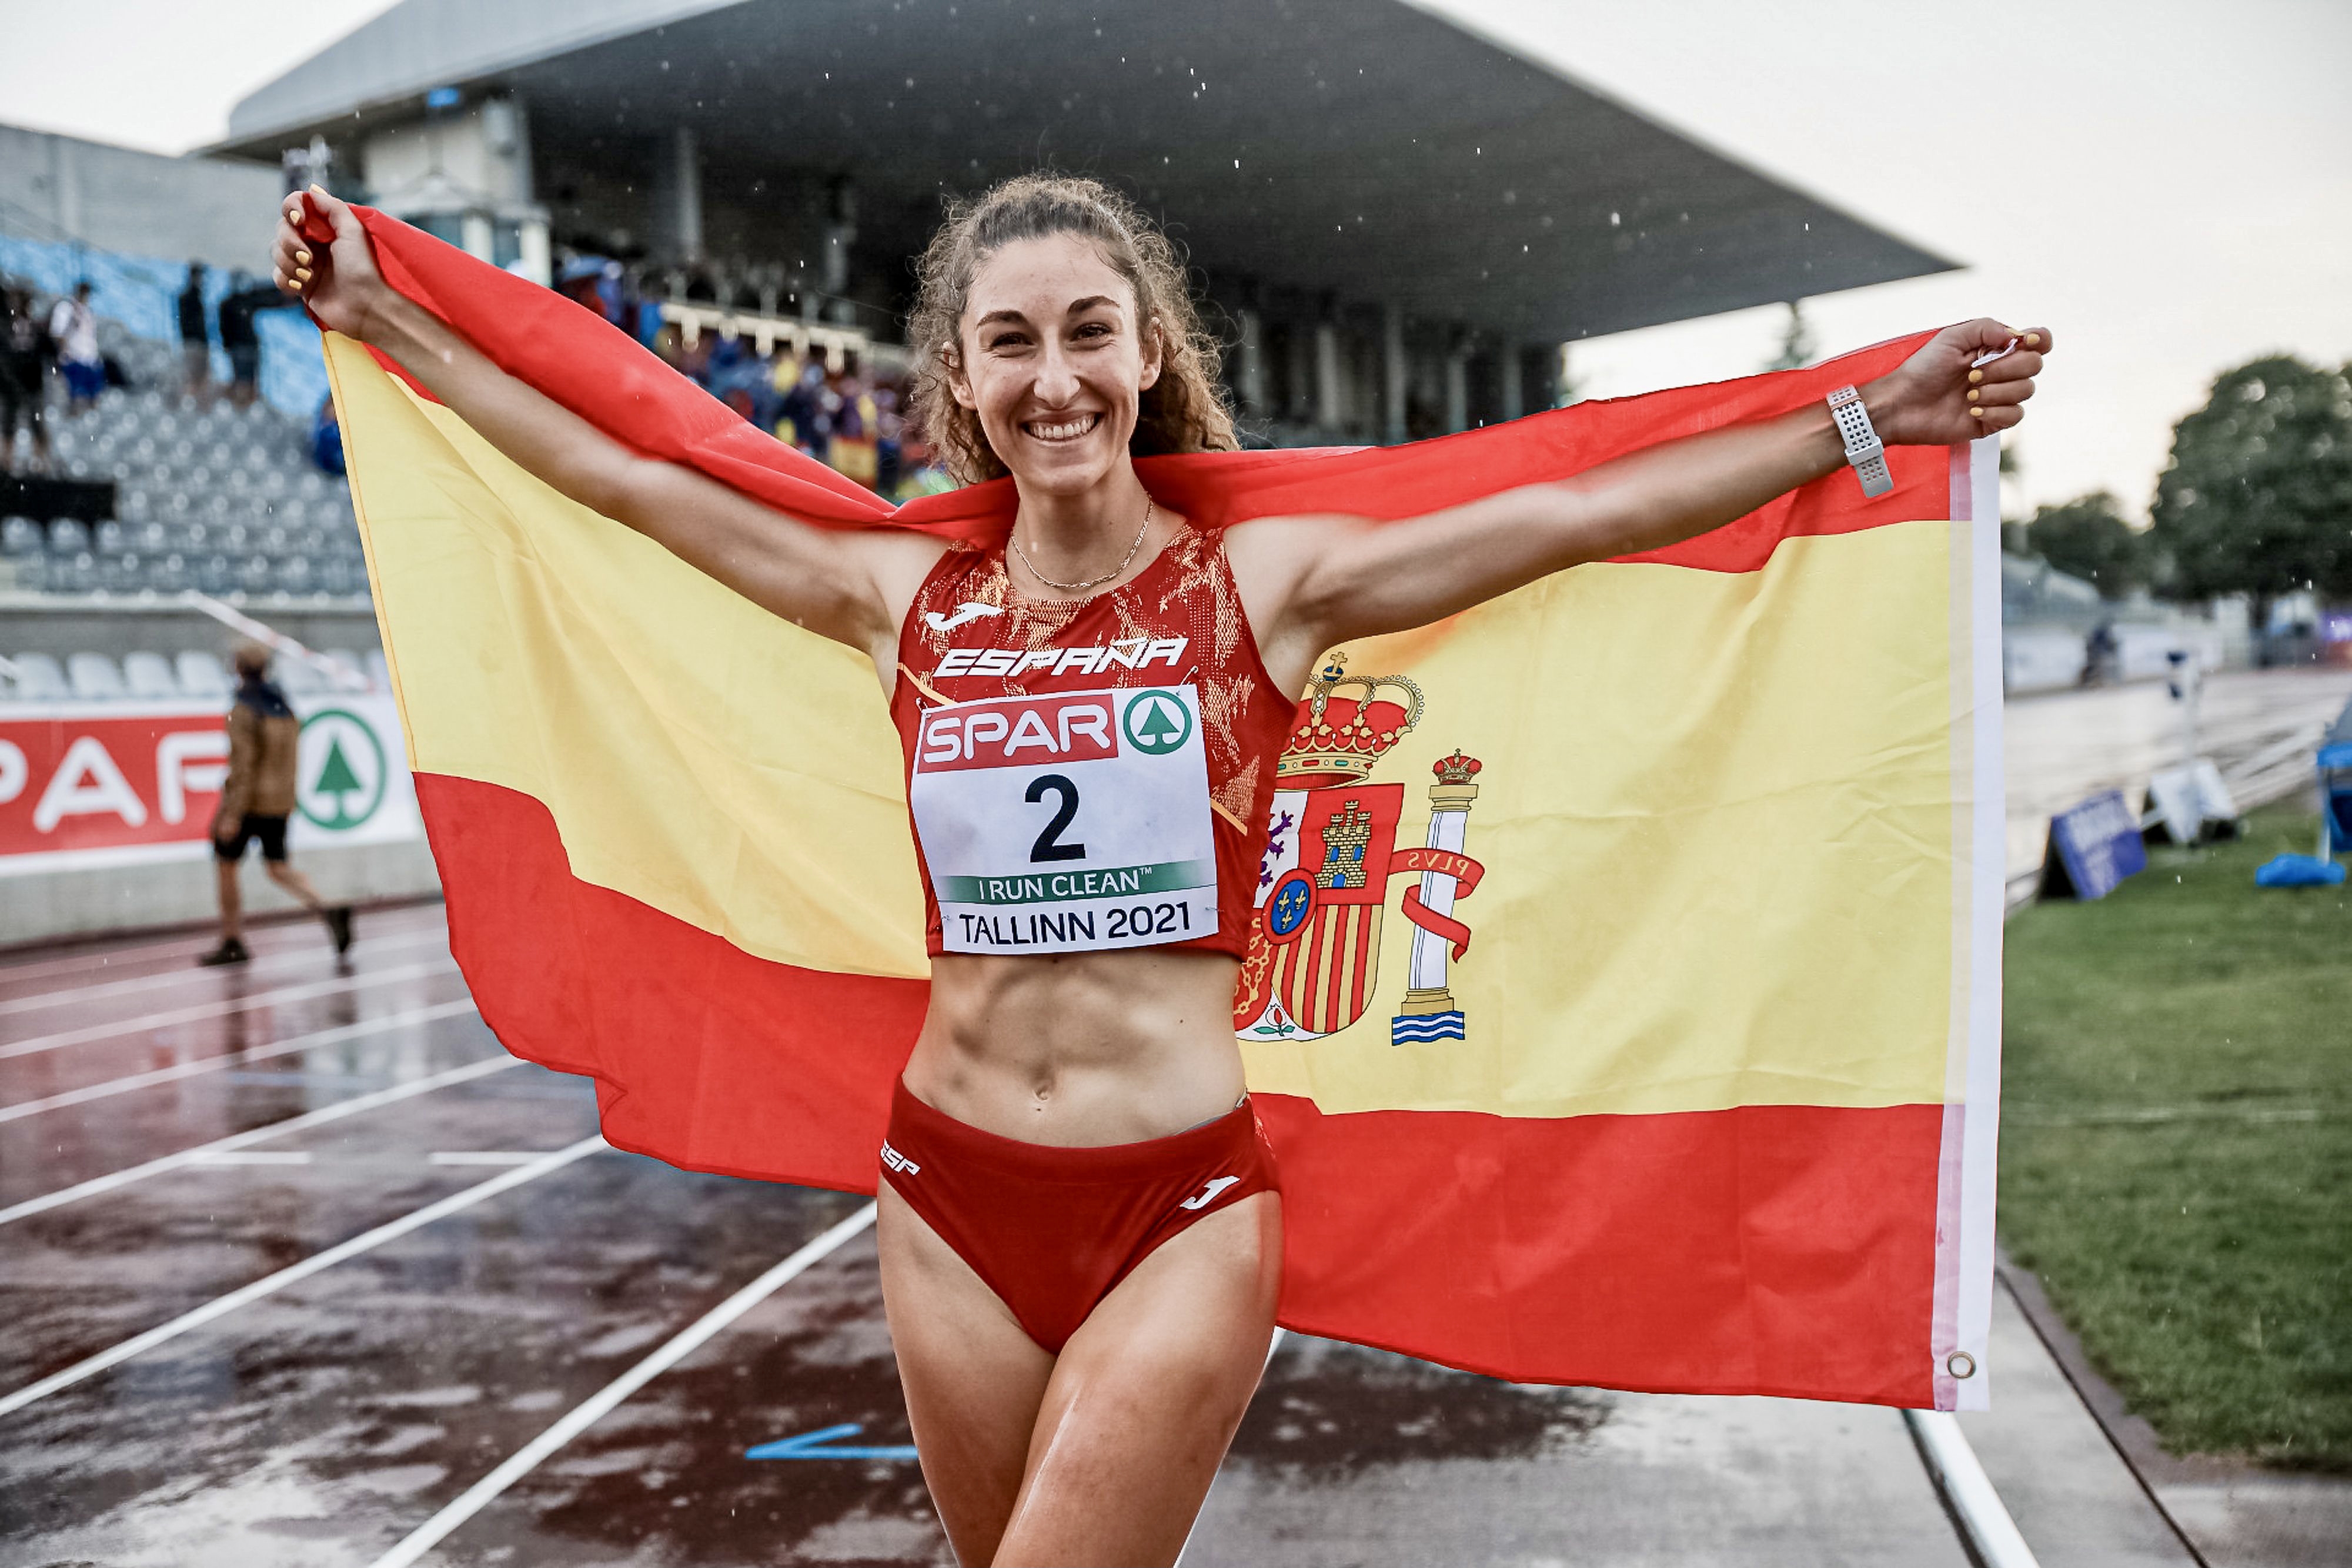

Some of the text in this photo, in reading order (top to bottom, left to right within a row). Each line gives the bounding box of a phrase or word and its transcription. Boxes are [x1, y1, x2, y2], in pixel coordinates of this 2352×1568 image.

[933, 637, 1188, 677] ESPAÑA
[923, 703, 1111, 763] SPAR
[1024, 774, 1086, 863] 2
[978, 880, 984, 900] I
[989, 878, 1044, 900] RUN
[959, 901, 1190, 945] TALLINN 2021
